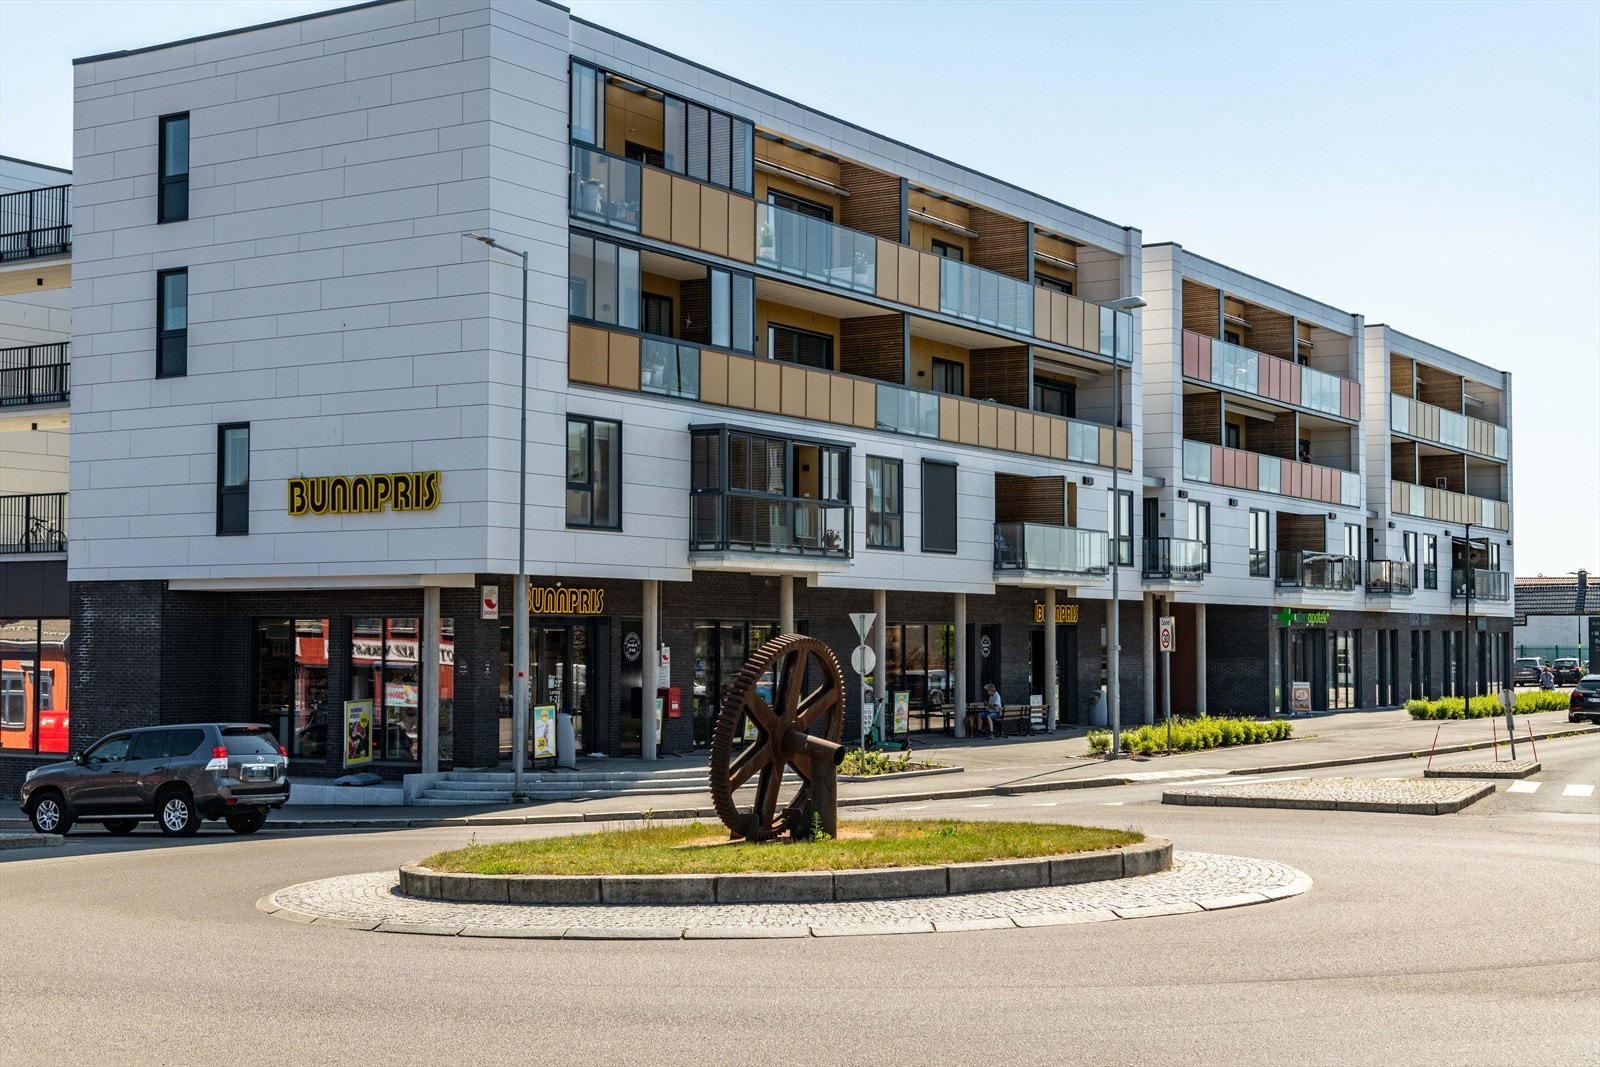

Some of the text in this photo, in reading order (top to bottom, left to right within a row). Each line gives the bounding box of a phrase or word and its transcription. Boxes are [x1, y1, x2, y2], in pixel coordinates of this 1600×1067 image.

[288, 470, 442, 516] BUNNPRIS
[1034, 604, 1079, 623] BNPRIS
[1162, 633, 1169, 643] 30
